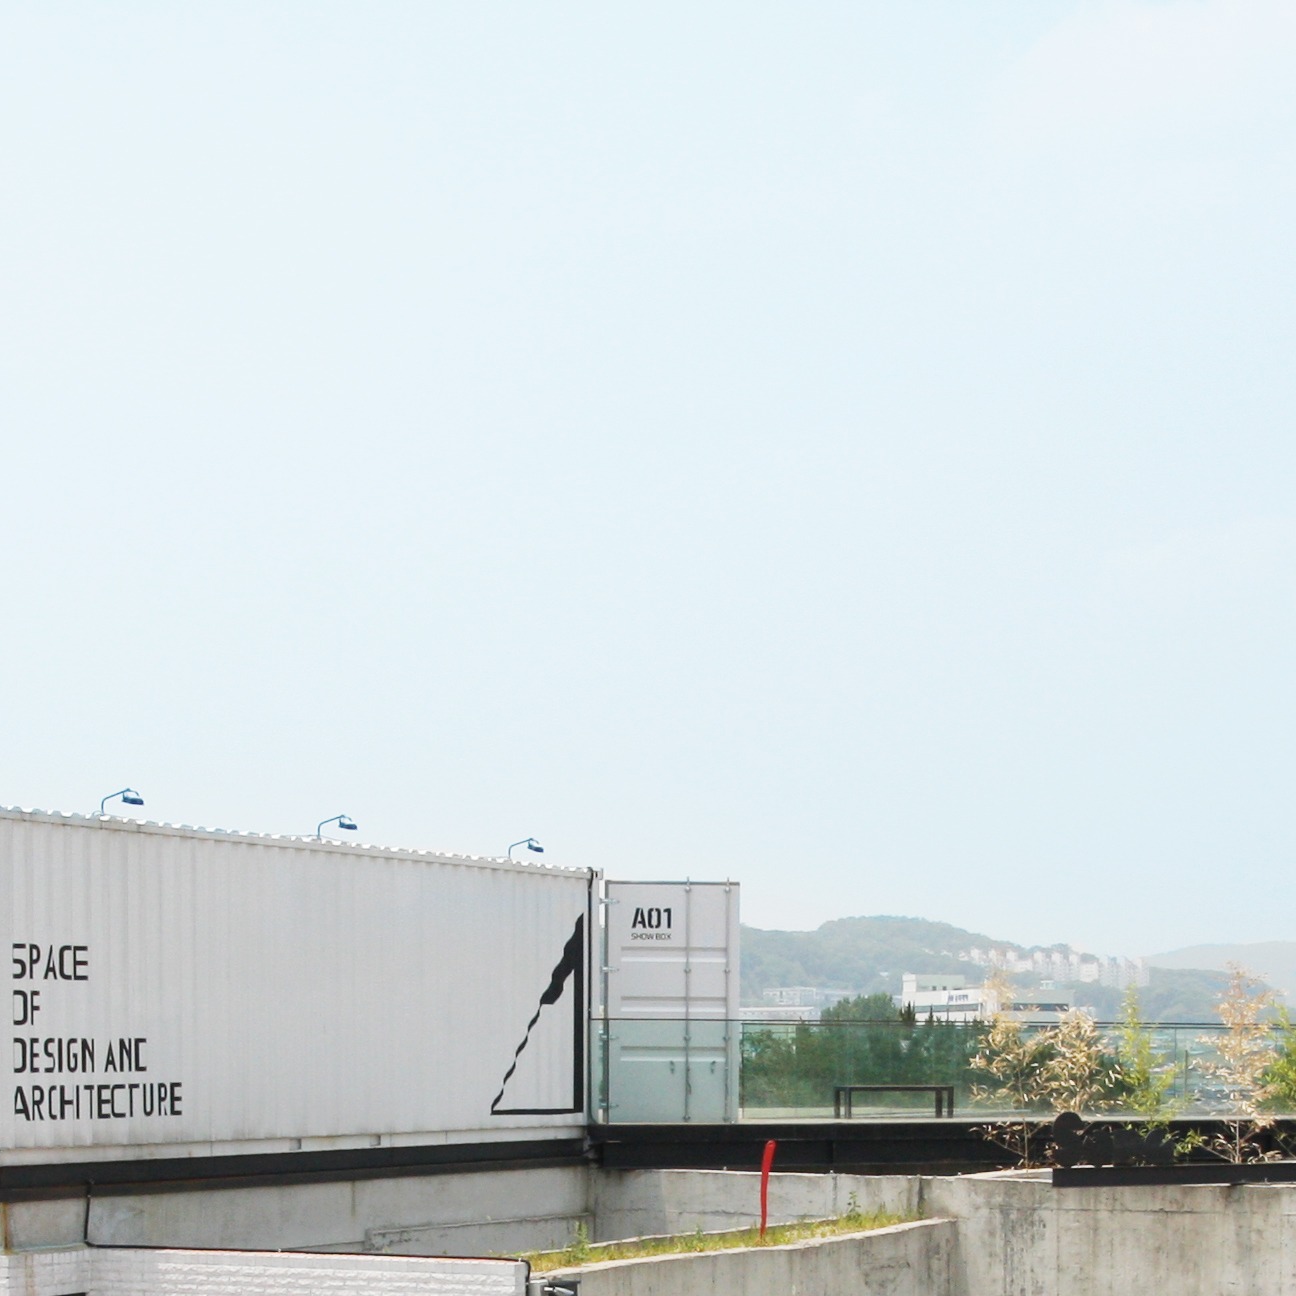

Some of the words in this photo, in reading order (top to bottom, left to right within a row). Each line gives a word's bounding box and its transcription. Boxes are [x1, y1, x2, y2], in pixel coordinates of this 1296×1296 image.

[632, 908, 672, 928] A01
[631, 932, 653, 940] SHOW
[656, 932, 671, 940] BOX
[13, 944, 88, 980] SPACE
[13, 990, 40, 1025] OF
[14, 1038, 94, 1073] DESIGN
[14, 1082, 182, 1121] ARCHITECTURE
